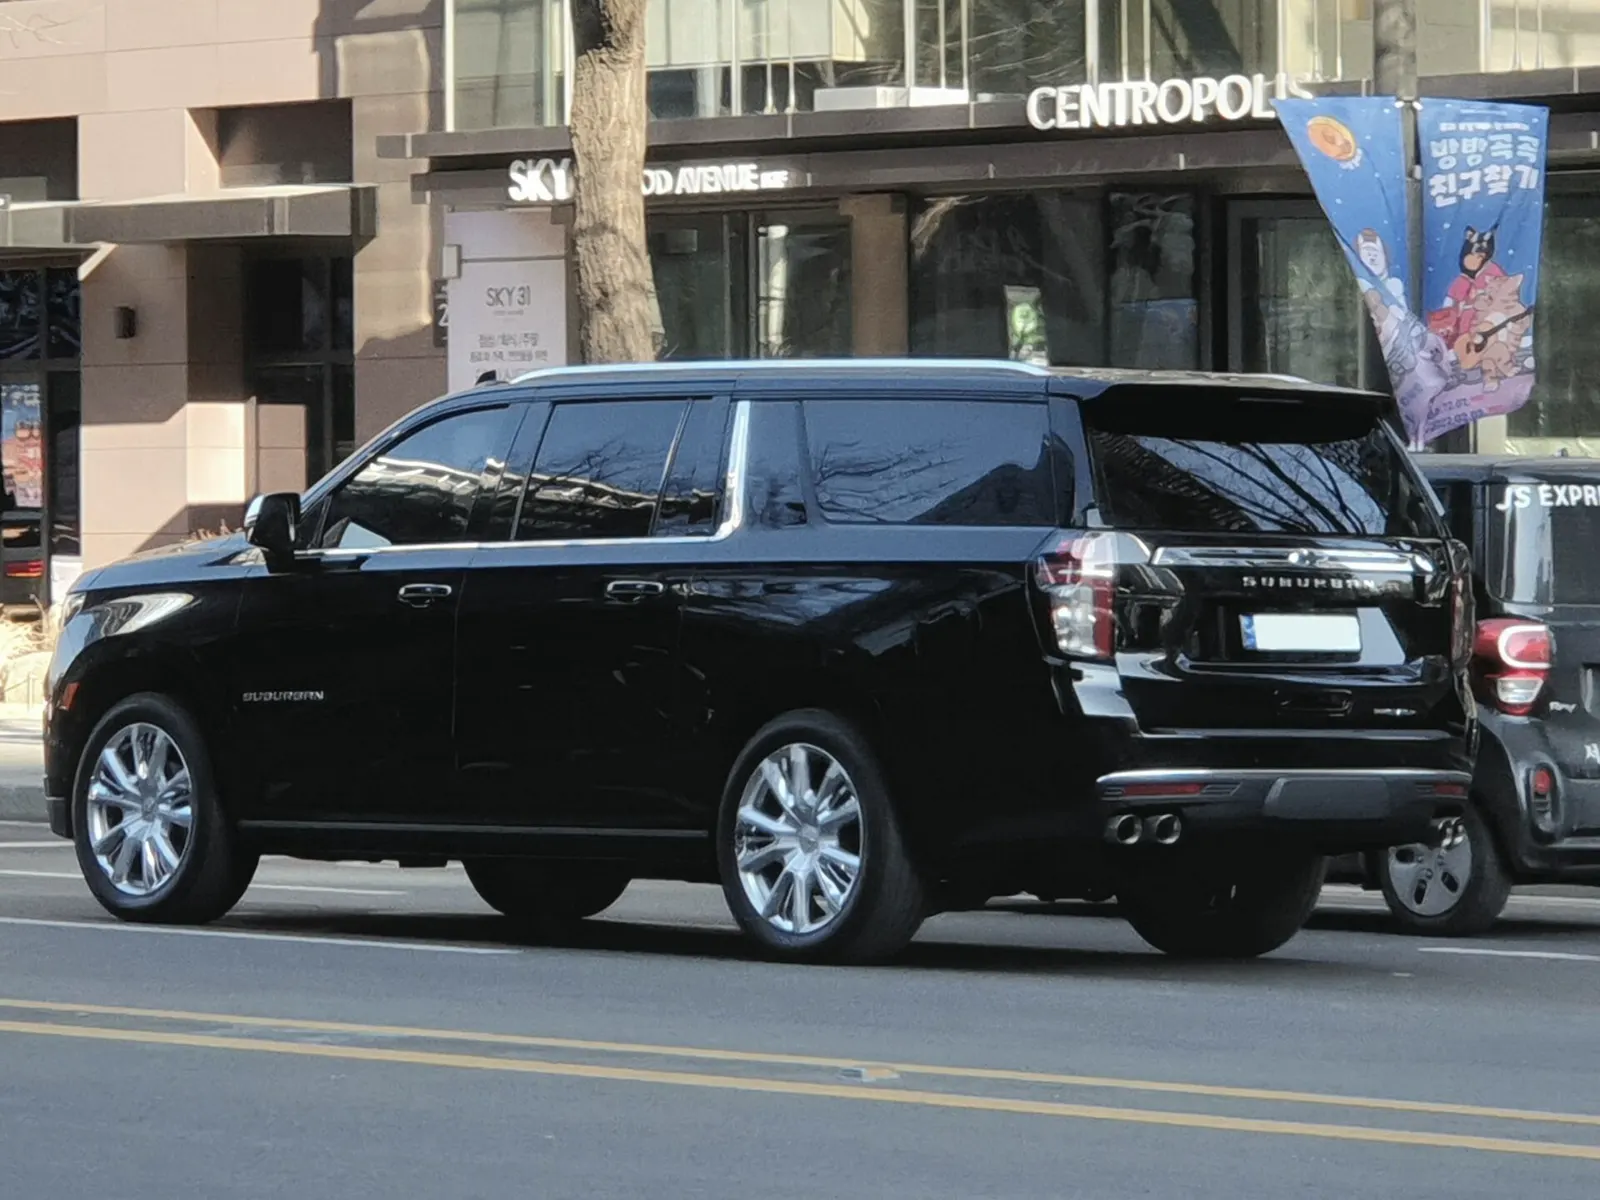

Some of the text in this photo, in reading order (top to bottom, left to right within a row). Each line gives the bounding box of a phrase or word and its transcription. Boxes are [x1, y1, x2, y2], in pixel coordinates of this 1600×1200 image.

[1430, 133, 1540, 171] 방방곡곡
[675, 163, 759, 195] AVENUE
[1429, 164, 1539, 208] 친구찾기
[486, 286, 515, 307] SKY
[1495, 484, 1600, 511] JS EXPR
[1242, 576, 1376, 590] SUBURBAN
[242, 690, 325, 702] SUBURBAN
